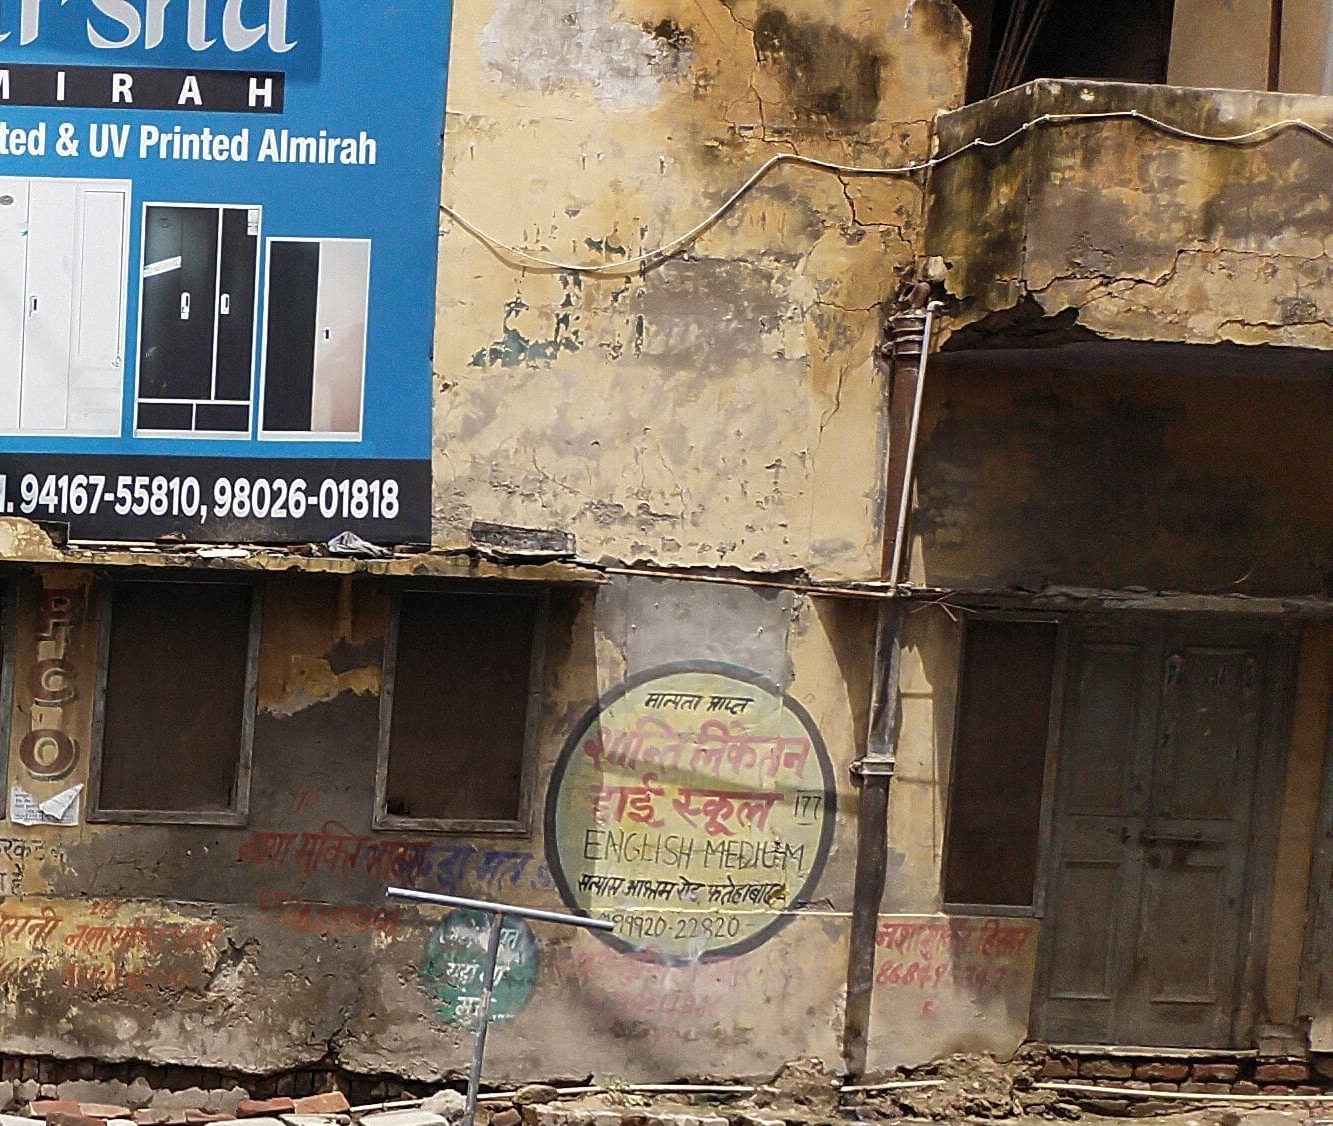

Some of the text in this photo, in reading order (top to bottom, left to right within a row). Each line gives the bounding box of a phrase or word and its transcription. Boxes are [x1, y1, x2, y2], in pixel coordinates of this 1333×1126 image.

[54, 126, 79, 157] &
[89, 124, 133, 159] UV
[138, 124, 249, 163] Printed
[256, 128, 377, 166] Almirah
[19, 474, 208, 524] 94167-55810,
[213, 478, 400, 519] 98026-01818
[589, 772, 666, 829] हाई
[671, 786, 784, 837] स्कूल
[583, 828, 694, 870] ENGLISH
[704, 839, 806, 872] MEDIUM
